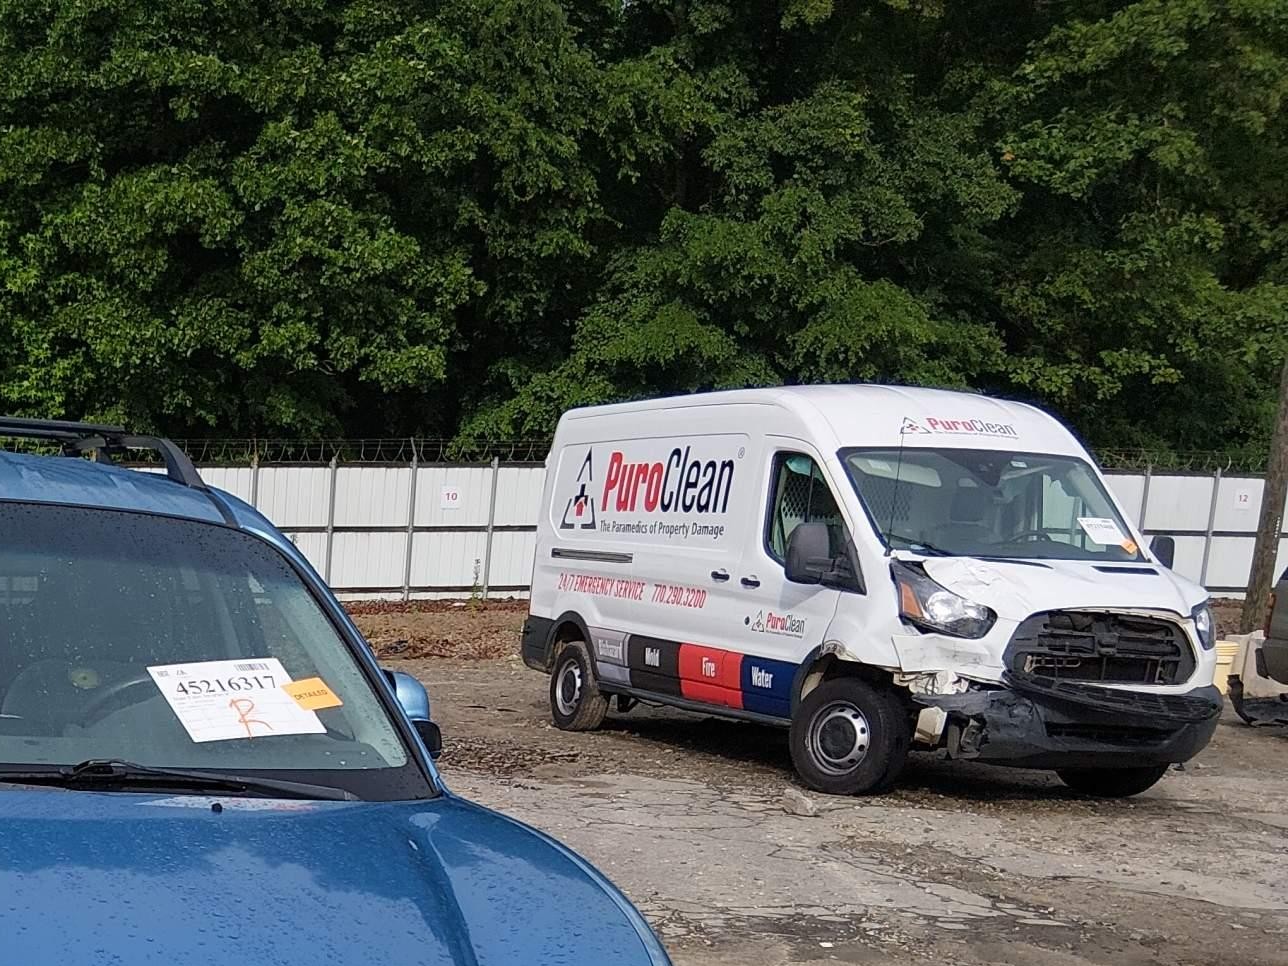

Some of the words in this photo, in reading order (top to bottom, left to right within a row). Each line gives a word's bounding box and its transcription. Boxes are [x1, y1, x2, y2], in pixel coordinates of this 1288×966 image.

[926, 417, 1017, 435] PuroClean
[445, 492, 458, 501] 10
[1239, 494, 1249, 503] 12
[600, 520, 611, 532] The
[611, 521, 648, 535] Paramedics
[649, 522, 657, 535] of
[656, 521, 690, 538] Property
[691, 522, 725, 539] Damage
[558, 572, 575, 592] 24/7
[574, 574, 615, 597] EMERGENCY
[614, 580, 646, 601] SERVICE
[651, 583, 707, 609] 770.290.3200
[644, 647, 660, 667] Mold
[702, 656, 716, 677] Fire
[176, 675, 277, 696] 45216317
[751, 666, 774, 689] Water
[293, 689, 329, 701] DETAILED
